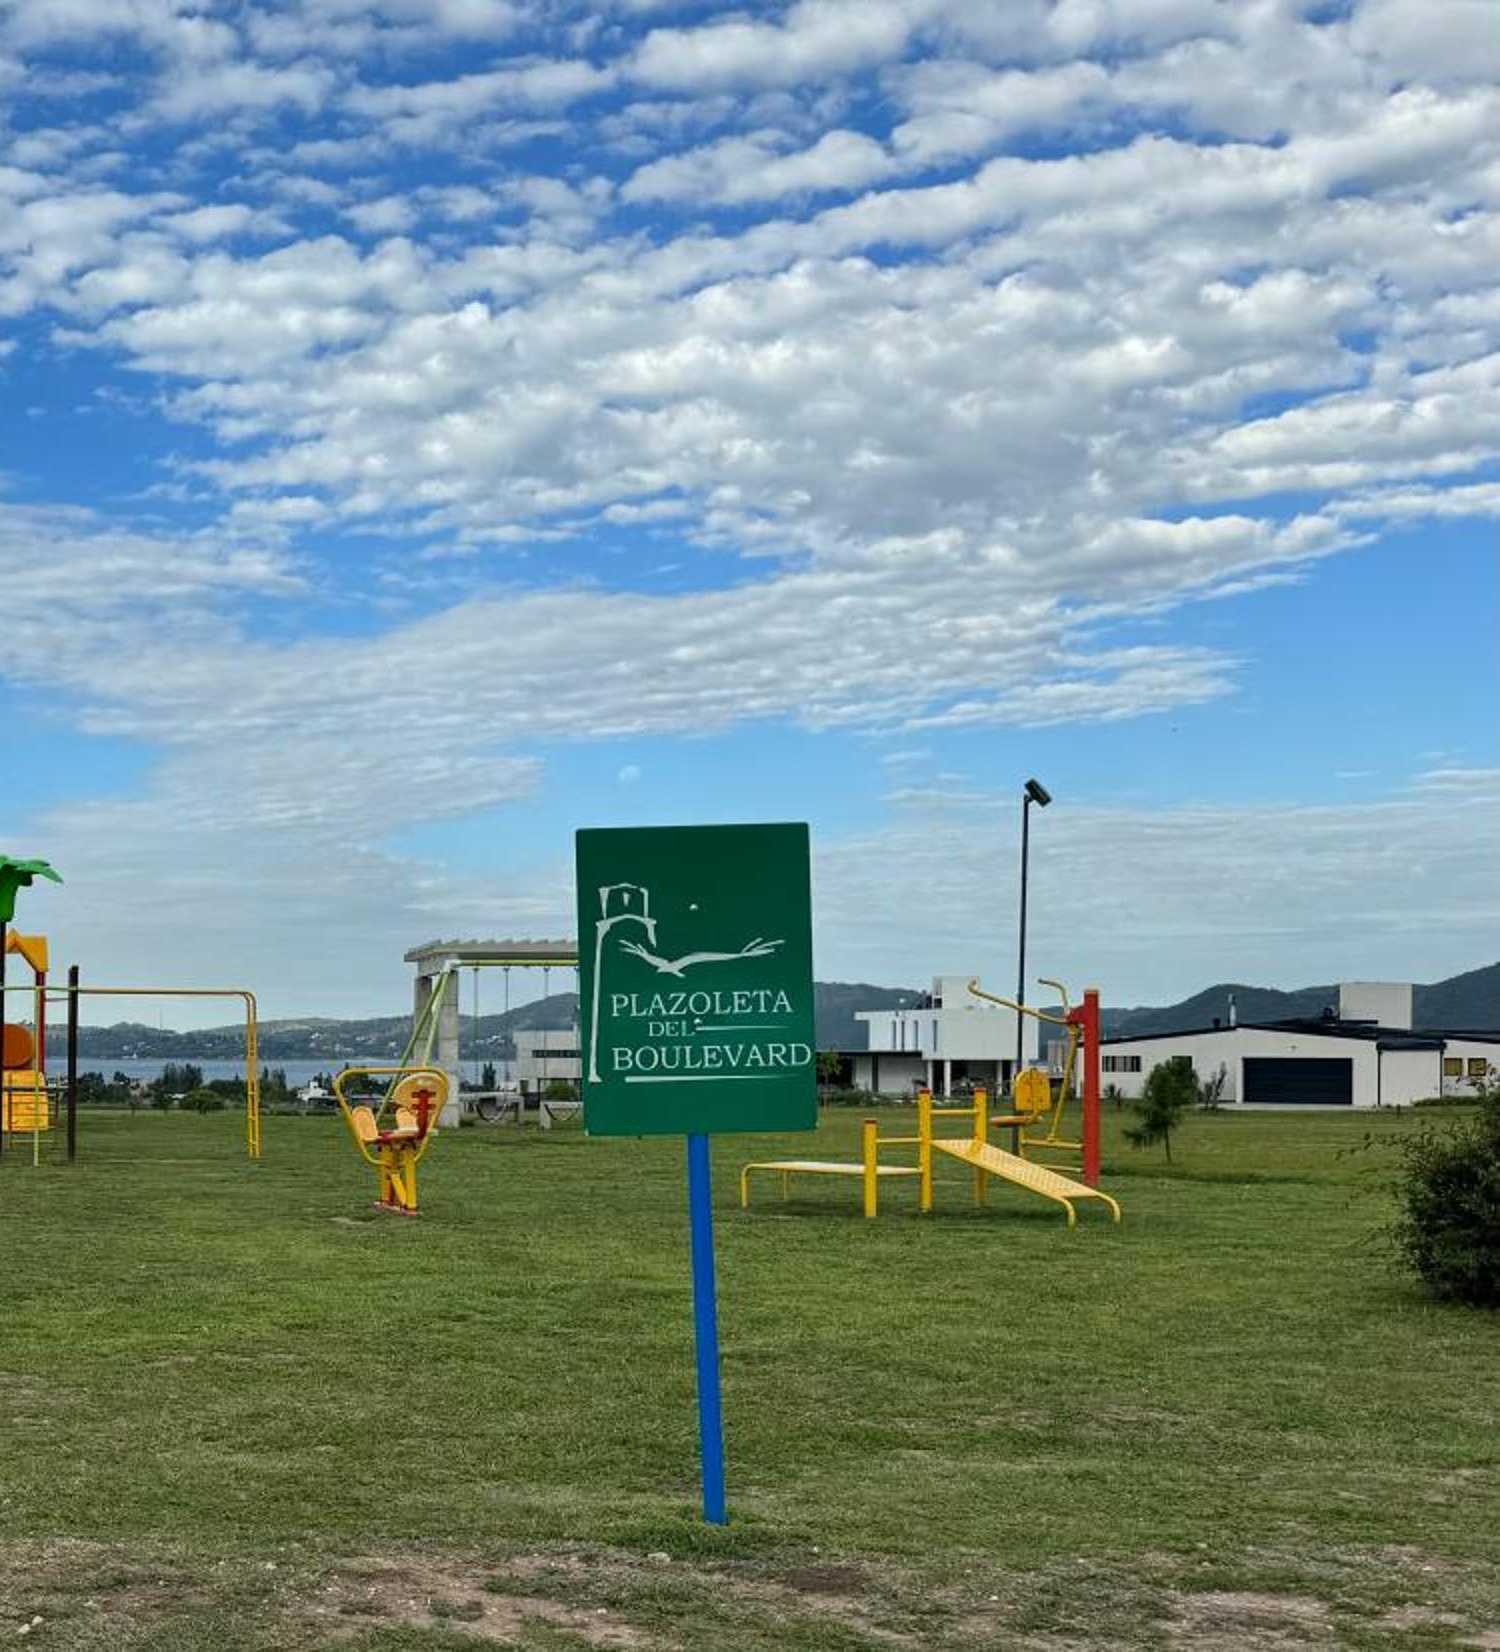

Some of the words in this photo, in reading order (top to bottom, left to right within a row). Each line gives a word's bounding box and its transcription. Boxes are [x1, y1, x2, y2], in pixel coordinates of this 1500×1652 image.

[611, 990, 793, 1016] PLAZOLETA
[649, 1020, 696, 1037] DEL
[612, 1043, 811, 1071] BOULEVARD
